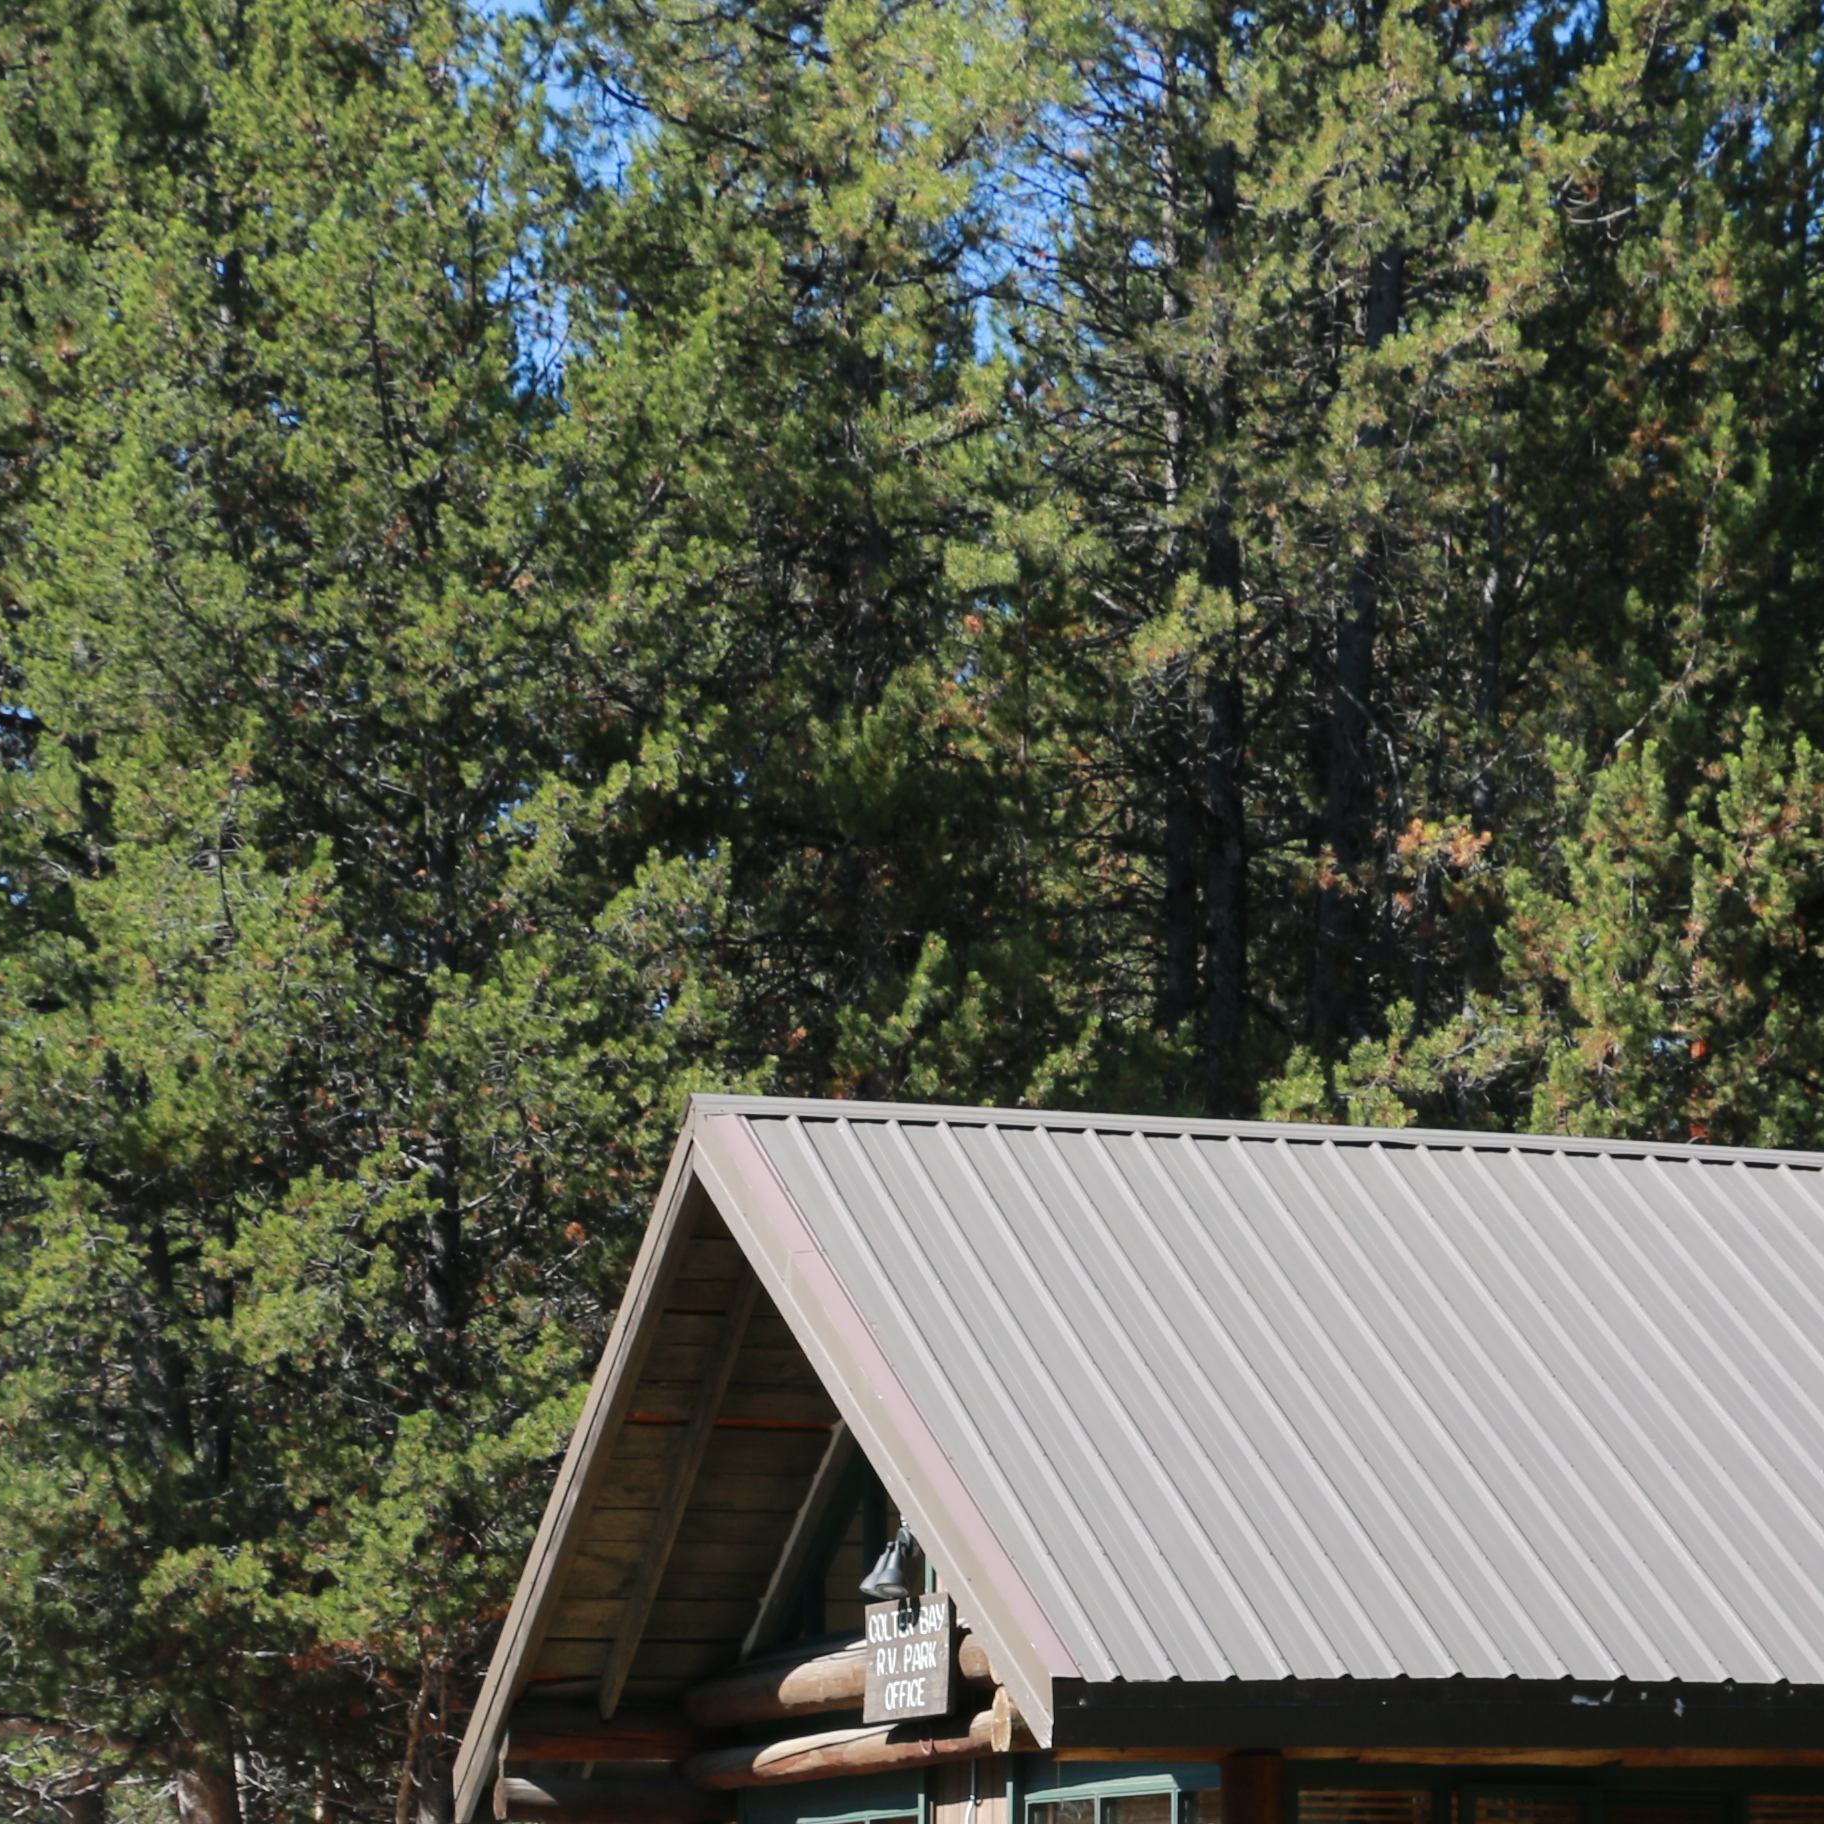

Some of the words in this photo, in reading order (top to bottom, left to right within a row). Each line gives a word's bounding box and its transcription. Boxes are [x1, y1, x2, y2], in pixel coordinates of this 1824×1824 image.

[867, 1610, 915, 1643] COLT
[919, 1603, 946, 1635] BAY
[876, 1646, 900, 1676] R.V.
[903, 1640, 937, 1673] PARK
[884, 1676, 926, 1711] OFFICE
